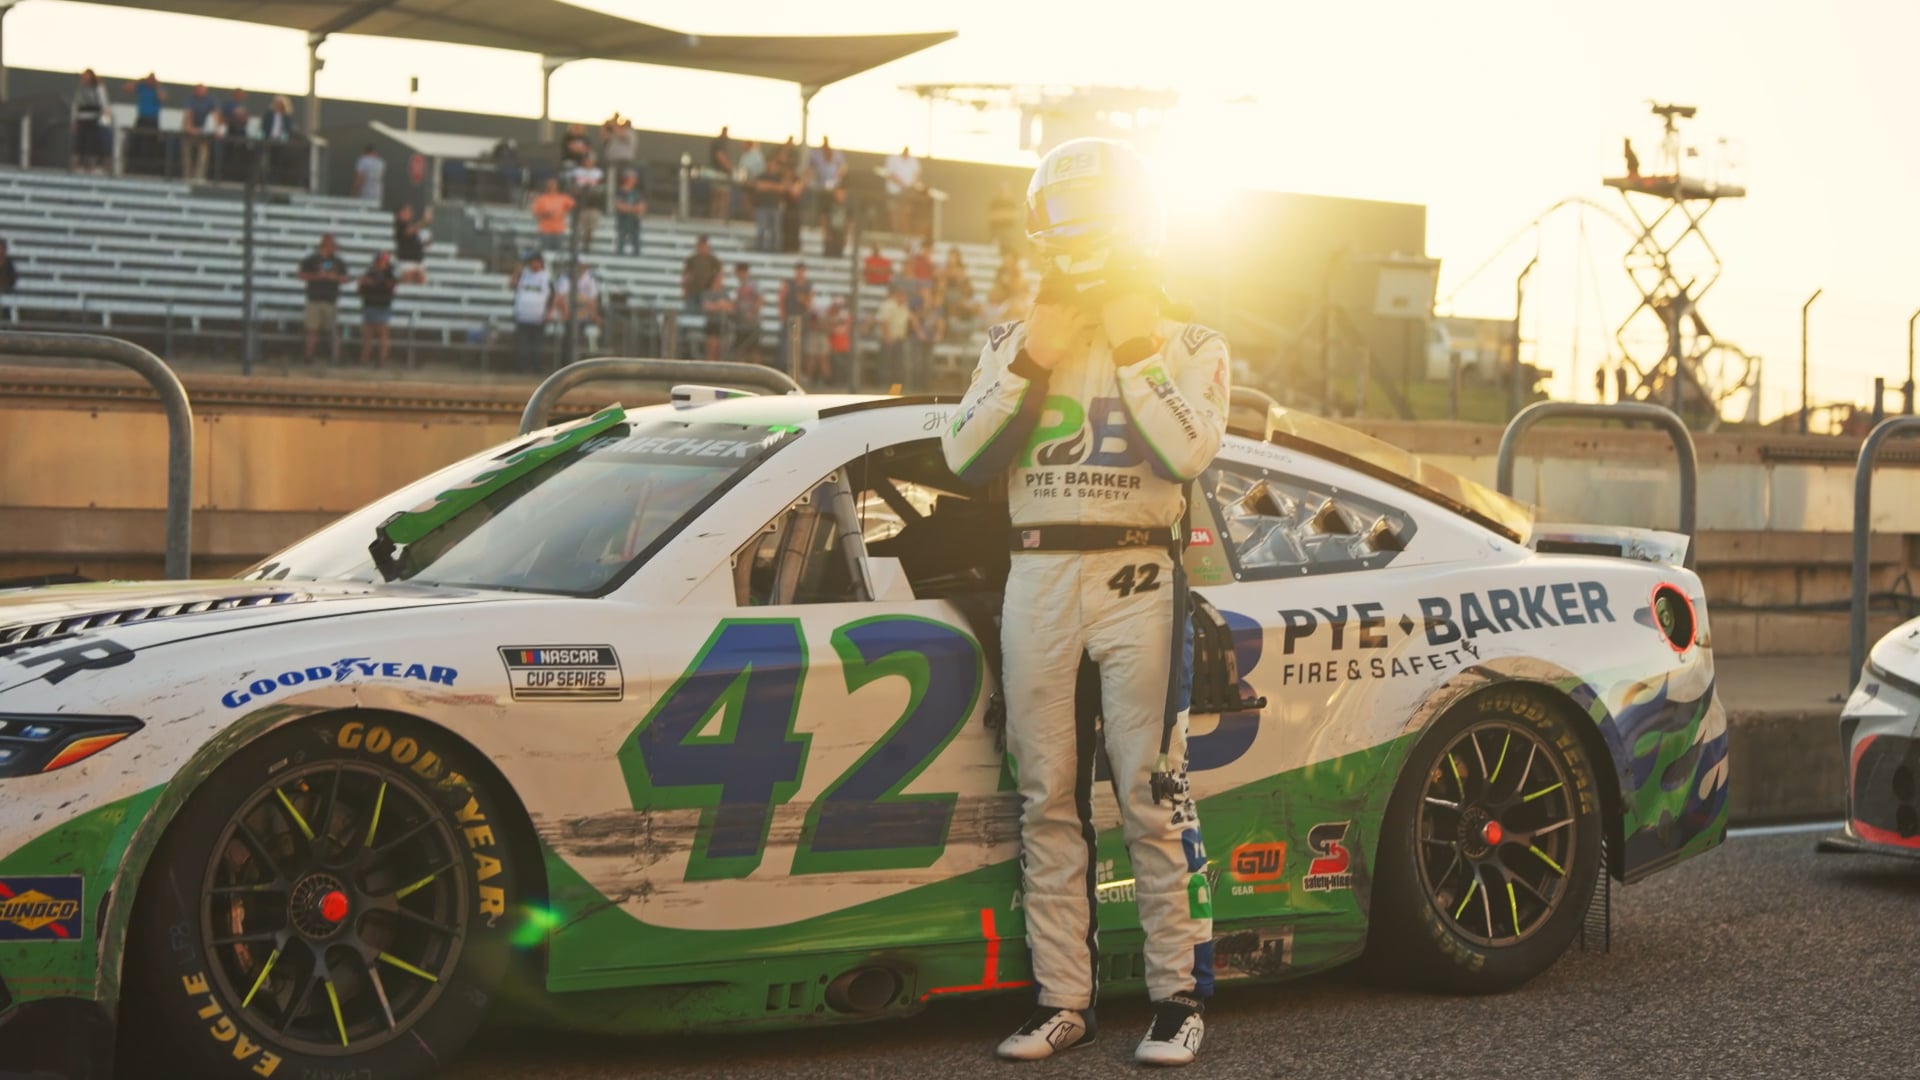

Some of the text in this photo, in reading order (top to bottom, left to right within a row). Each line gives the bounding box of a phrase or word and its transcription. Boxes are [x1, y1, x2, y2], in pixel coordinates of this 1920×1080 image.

[1025, 472, 1141, 489] PYE BARKER
[1033, 488, 1058, 497] FIRE
[1077, 488, 1130, 500] SAFETY
[1107, 562, 1161, 598] 42
[1278, 581, 1616, 655] PYE BARKER
[539, 649, 599, 664] NASCAR
[1283, 645, 1482, 685] FIRE & SAFETY
[221, 657, 458, 709] GOODYEAR
[526, 671, 606, 687] CUP SERIES
[618, 614, 983, 882] 42
[182, 972, 282, 1078] EAGLE
